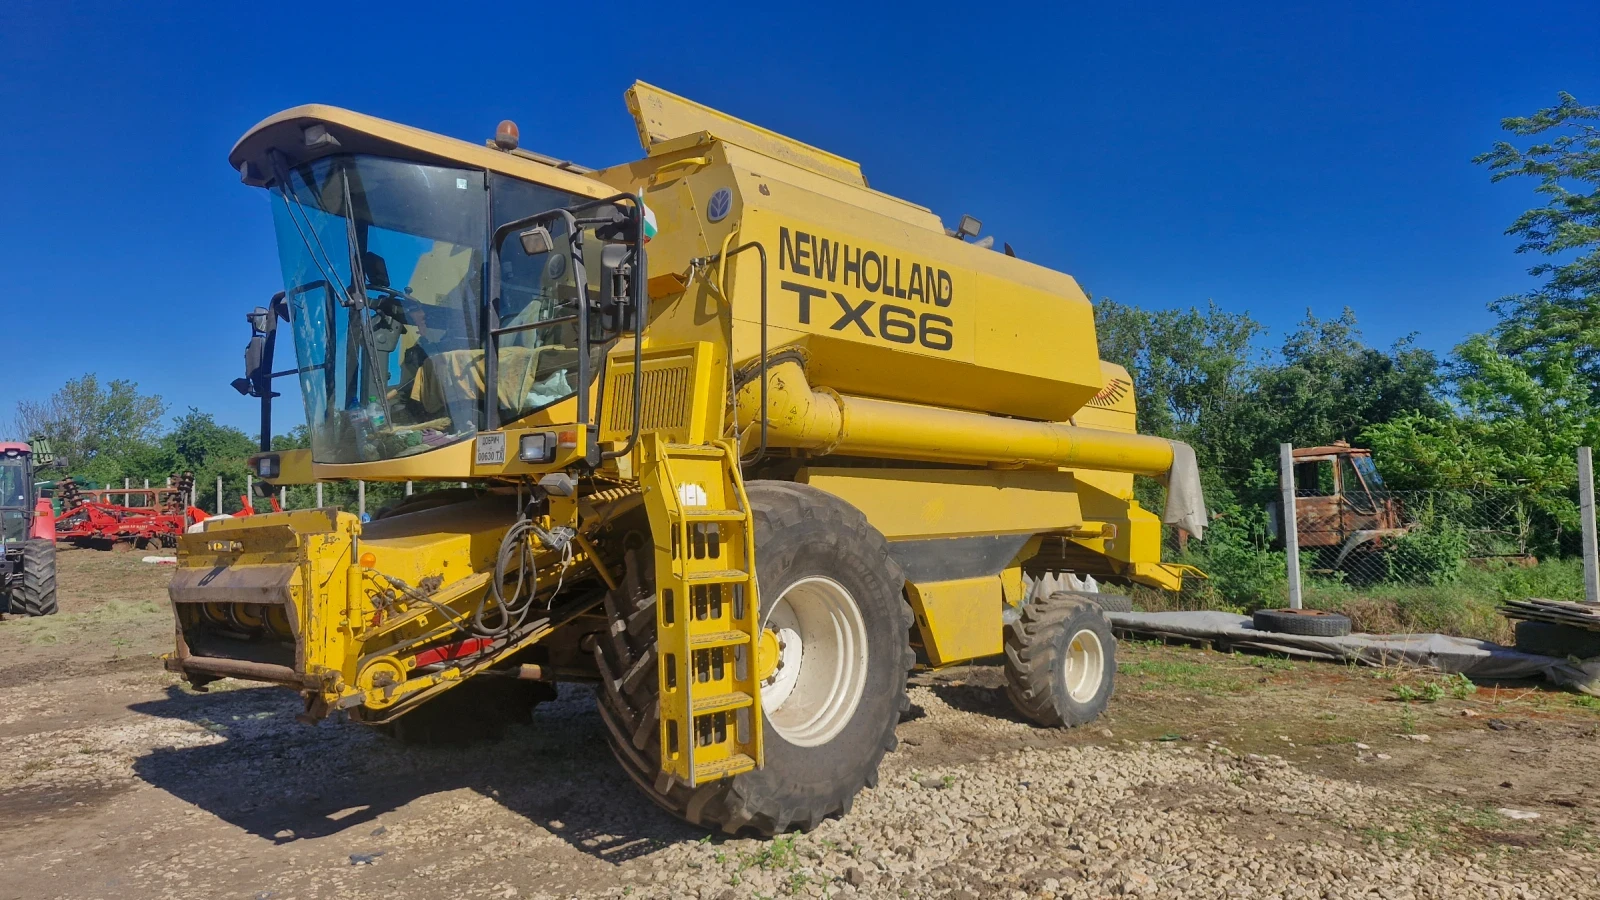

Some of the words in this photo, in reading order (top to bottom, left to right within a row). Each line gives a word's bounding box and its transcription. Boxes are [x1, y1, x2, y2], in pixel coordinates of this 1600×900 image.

[779, 226, 839, 283] NEW
[843, 243, 953, 308] HOLLAND
[780, 280, 953, 351] TX66
[482, 436, 500, 446] ДОБРИЧ
